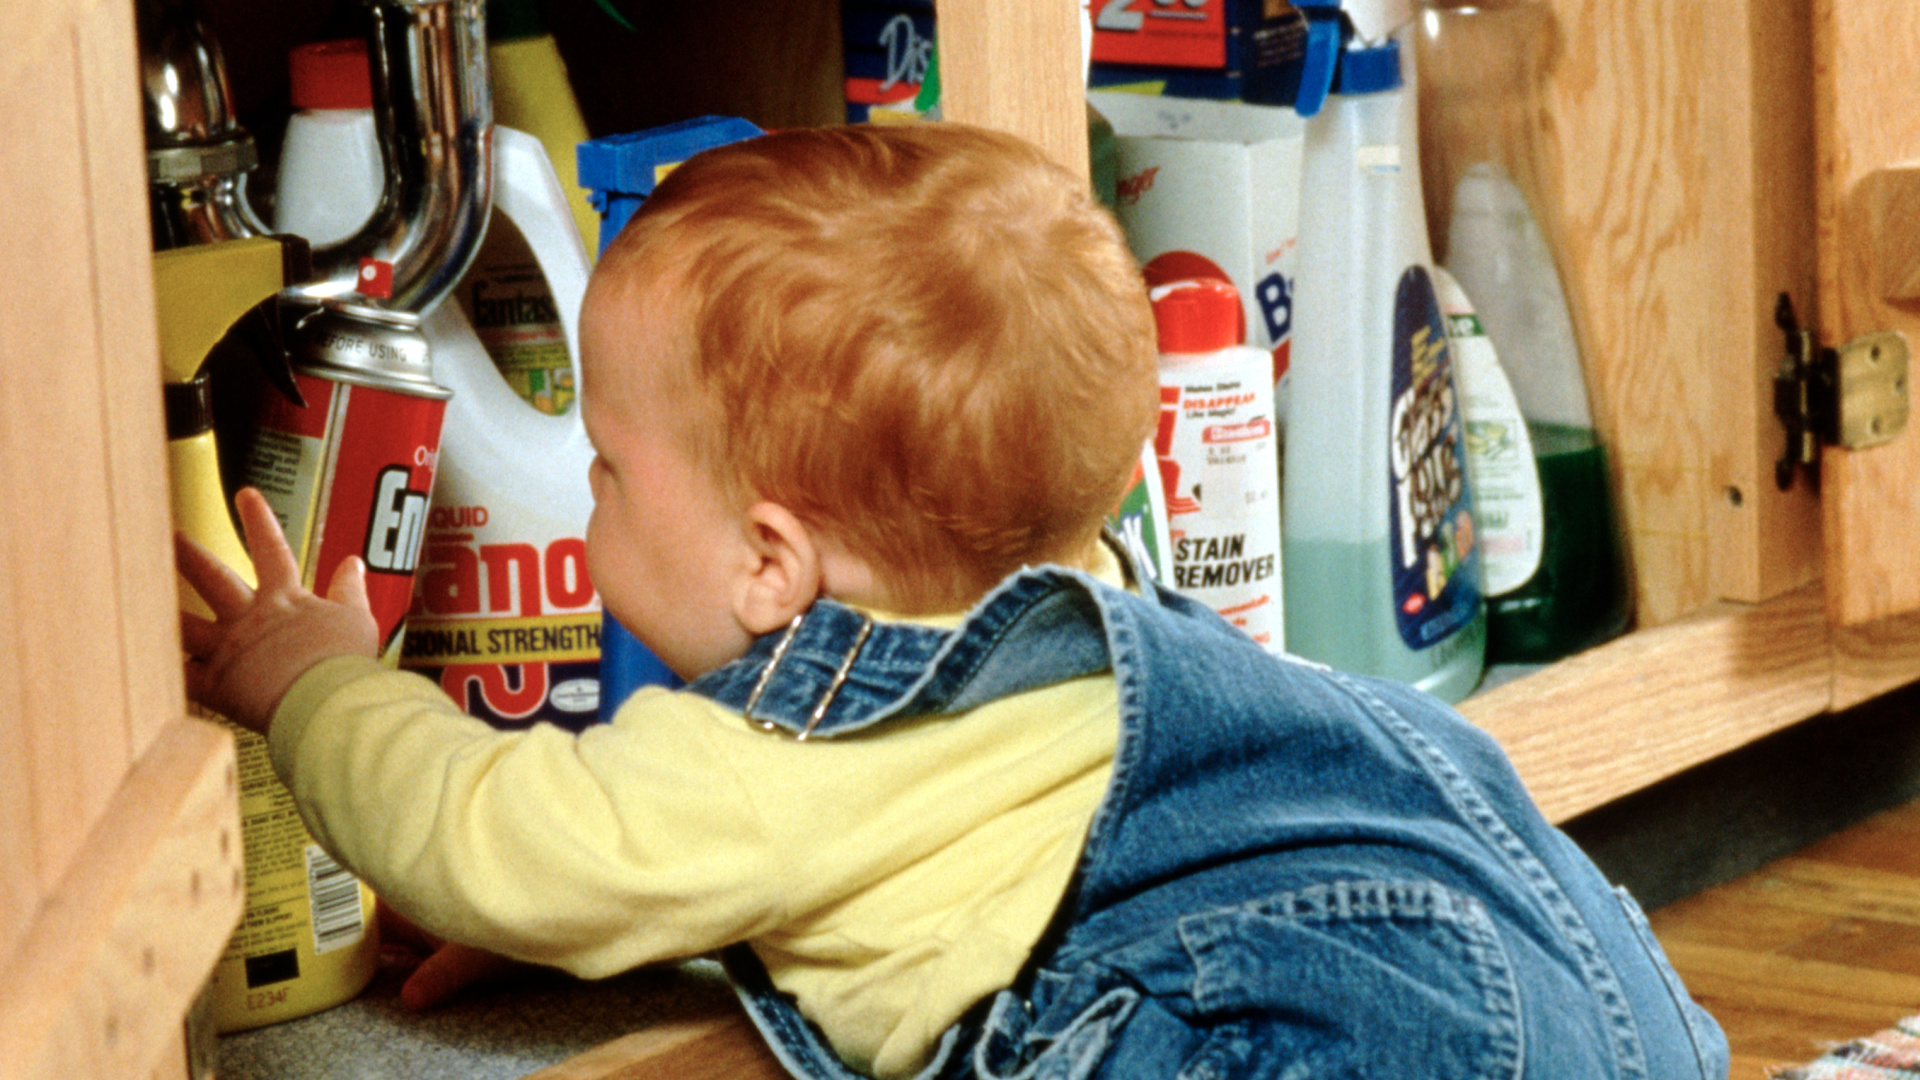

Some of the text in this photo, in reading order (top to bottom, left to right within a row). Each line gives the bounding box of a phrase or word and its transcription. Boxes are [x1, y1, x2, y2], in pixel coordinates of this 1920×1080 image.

[1255, 271, 1294, 344] B
[368, 341, 407, 362] USING
[1175, 534, 1246, 562] STAIN
[410, 533, 597, 617] ano
[1173, 553, 1275, 589] REMOVER
[487, 623, 601, 656] STRENGTH
